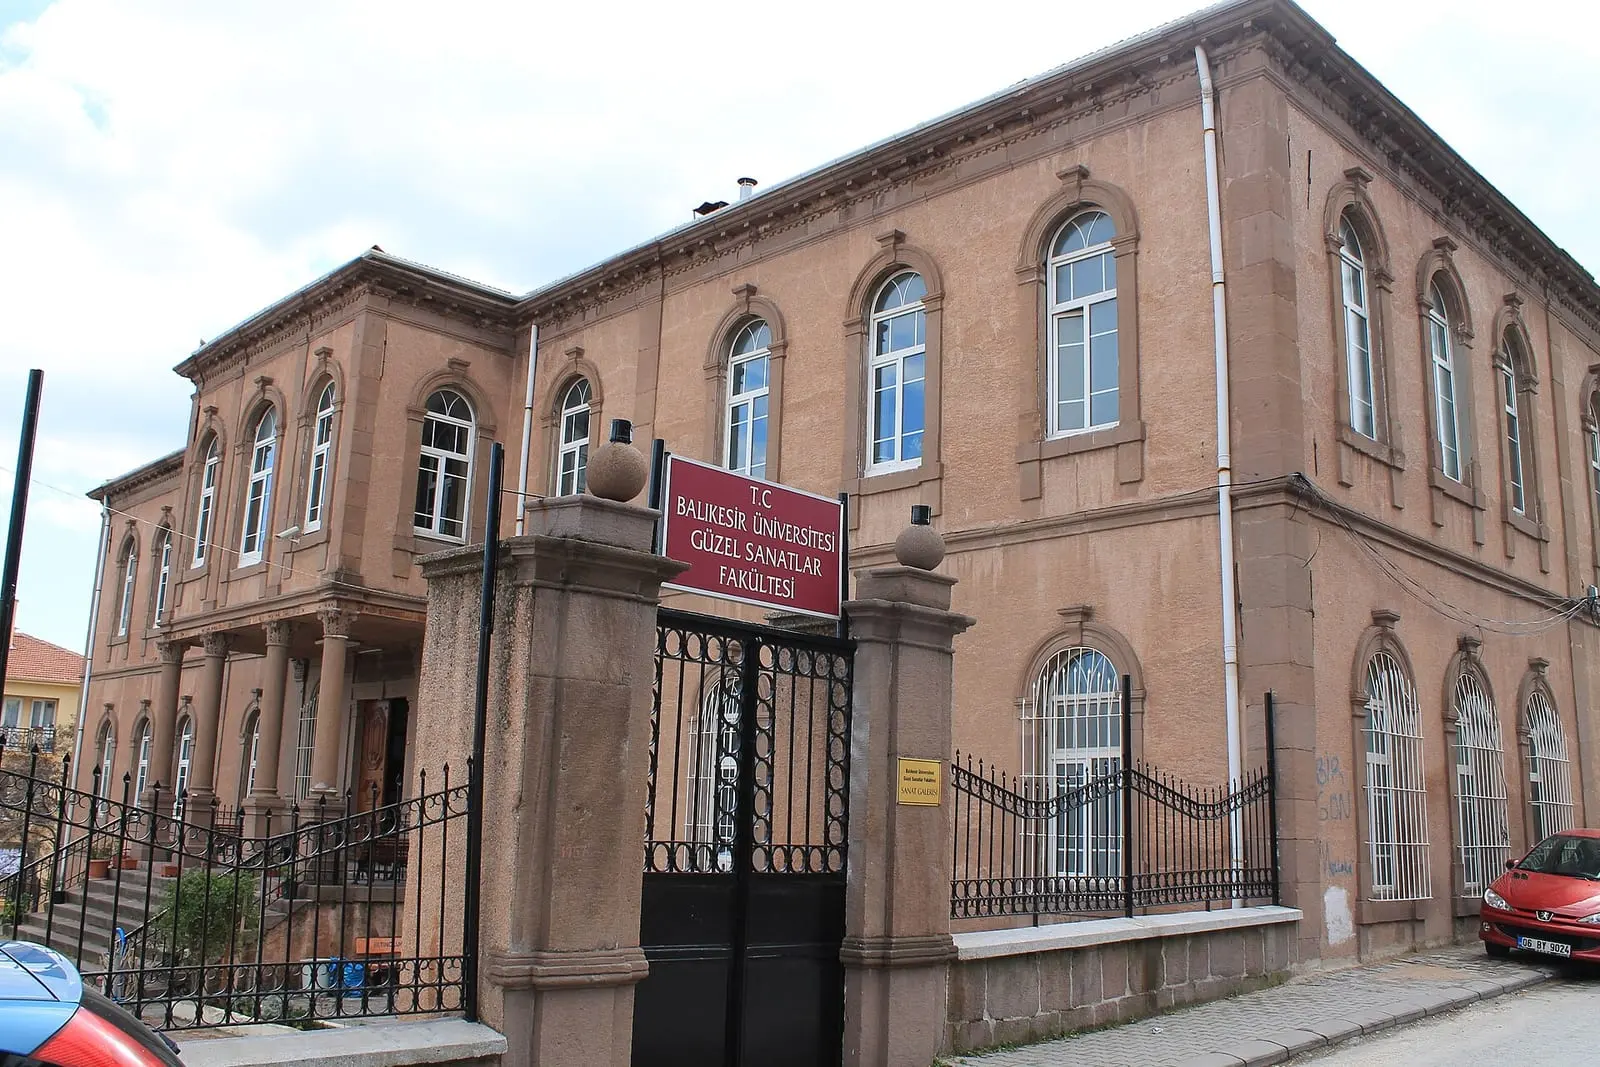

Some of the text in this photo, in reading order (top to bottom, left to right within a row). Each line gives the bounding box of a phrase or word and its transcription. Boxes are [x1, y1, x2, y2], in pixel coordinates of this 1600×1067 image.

[750, 485, 772, 509] T.C
[677, 496, 835, 553] BALIKESİR ÜNİVERSİTESİ
[690, 528, 822, 577] GÜZEL SANATLAR
[719, 565, 796, 599] FAKÜLTESİ
[1522, 938, 1532, 947] 06
[1537, 941, 1546, 949] BY
[1550, 943, 1569, 954] 9024
